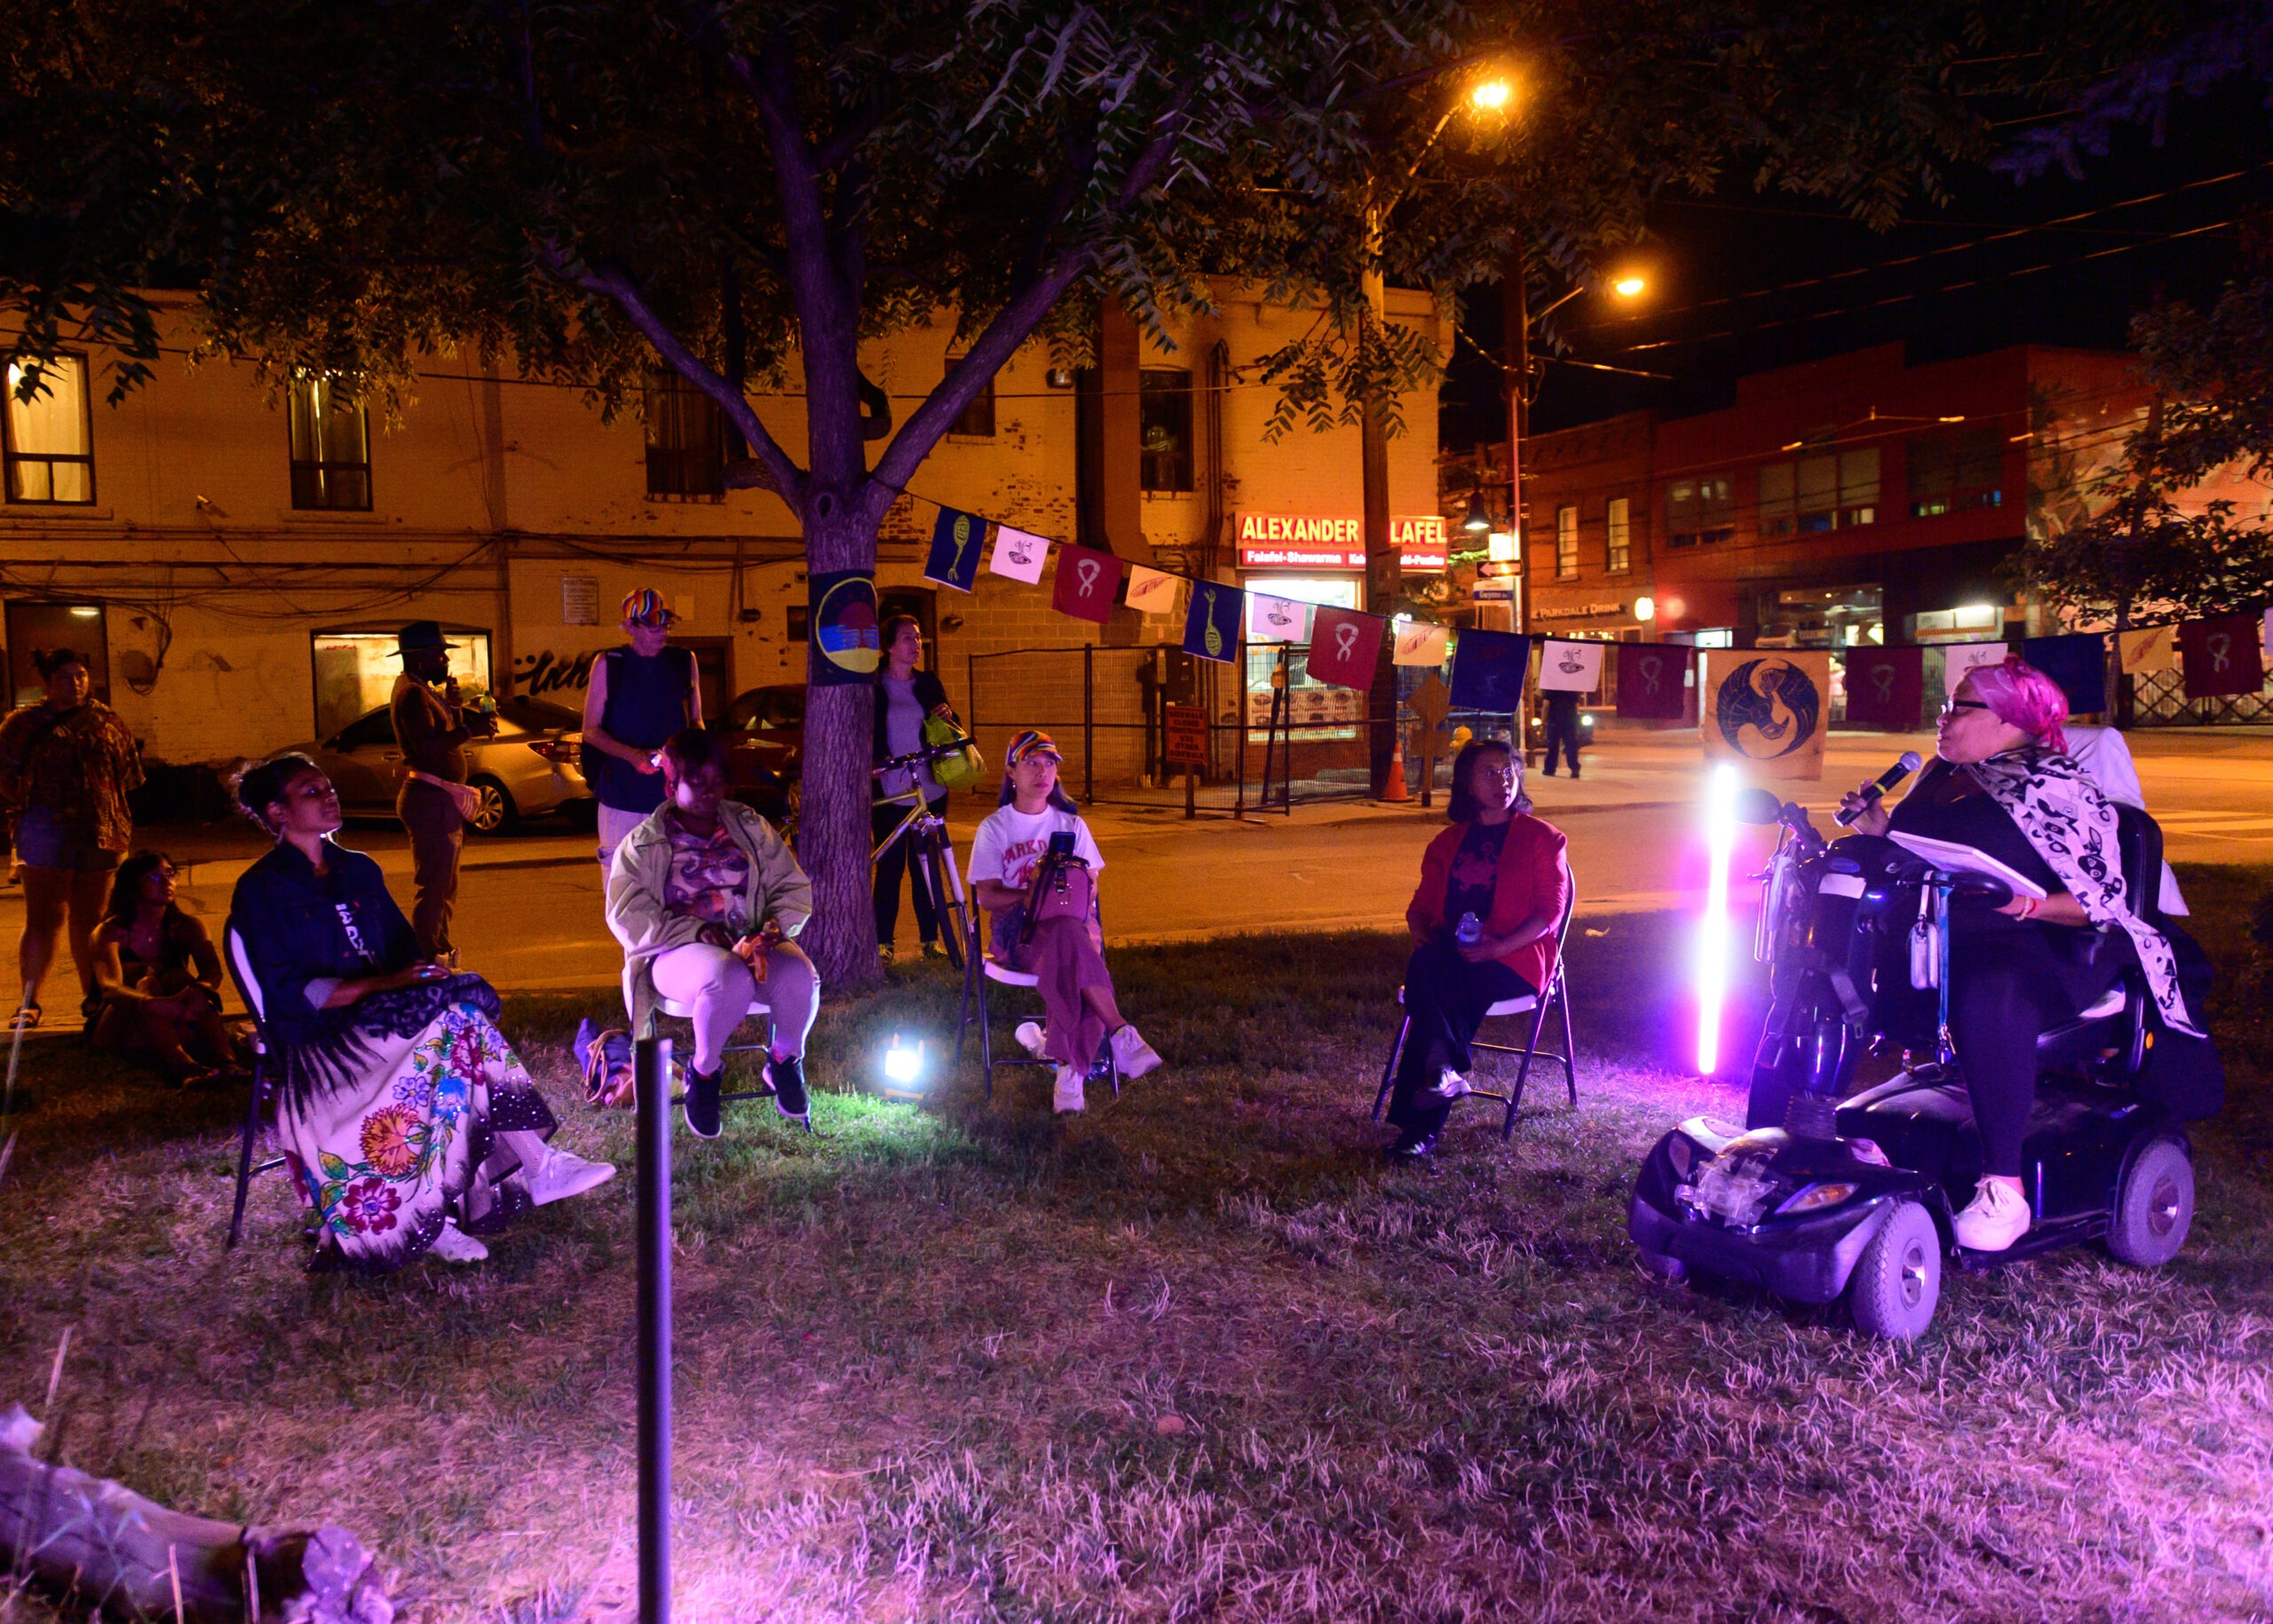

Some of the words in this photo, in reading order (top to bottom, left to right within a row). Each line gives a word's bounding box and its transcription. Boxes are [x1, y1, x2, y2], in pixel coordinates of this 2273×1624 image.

[1242, 516, 1358, 543] ALEXANDER
[1390, 521, 1447, 543] LAFEL
[1540, 605, 1588, 619] PARKDALE
[1589, 603, 1620, 614] DRINK
